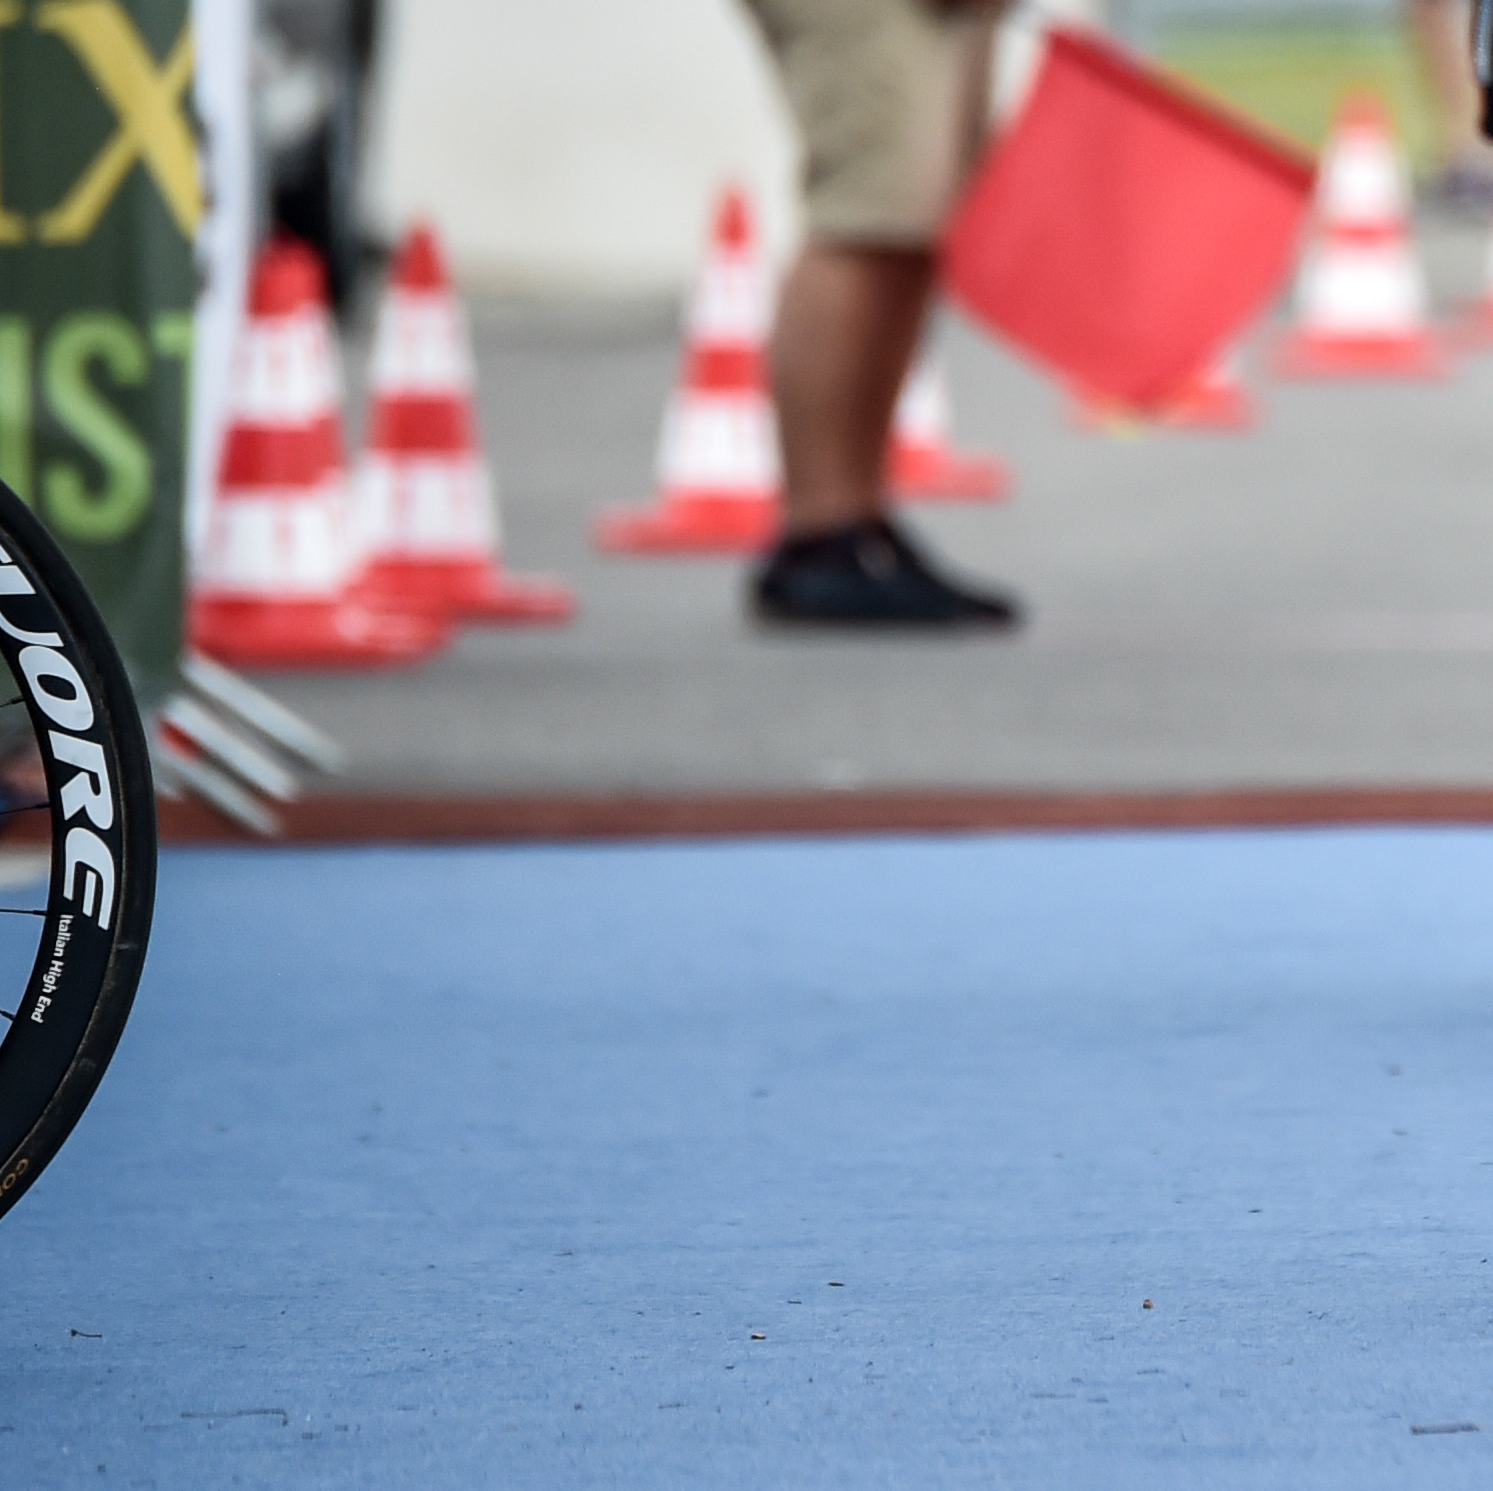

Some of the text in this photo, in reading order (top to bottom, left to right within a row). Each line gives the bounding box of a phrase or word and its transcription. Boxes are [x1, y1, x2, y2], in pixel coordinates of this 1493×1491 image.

[0, 544, 115, 930] UORE
[30, 913, 74, 1024] Italian High End
